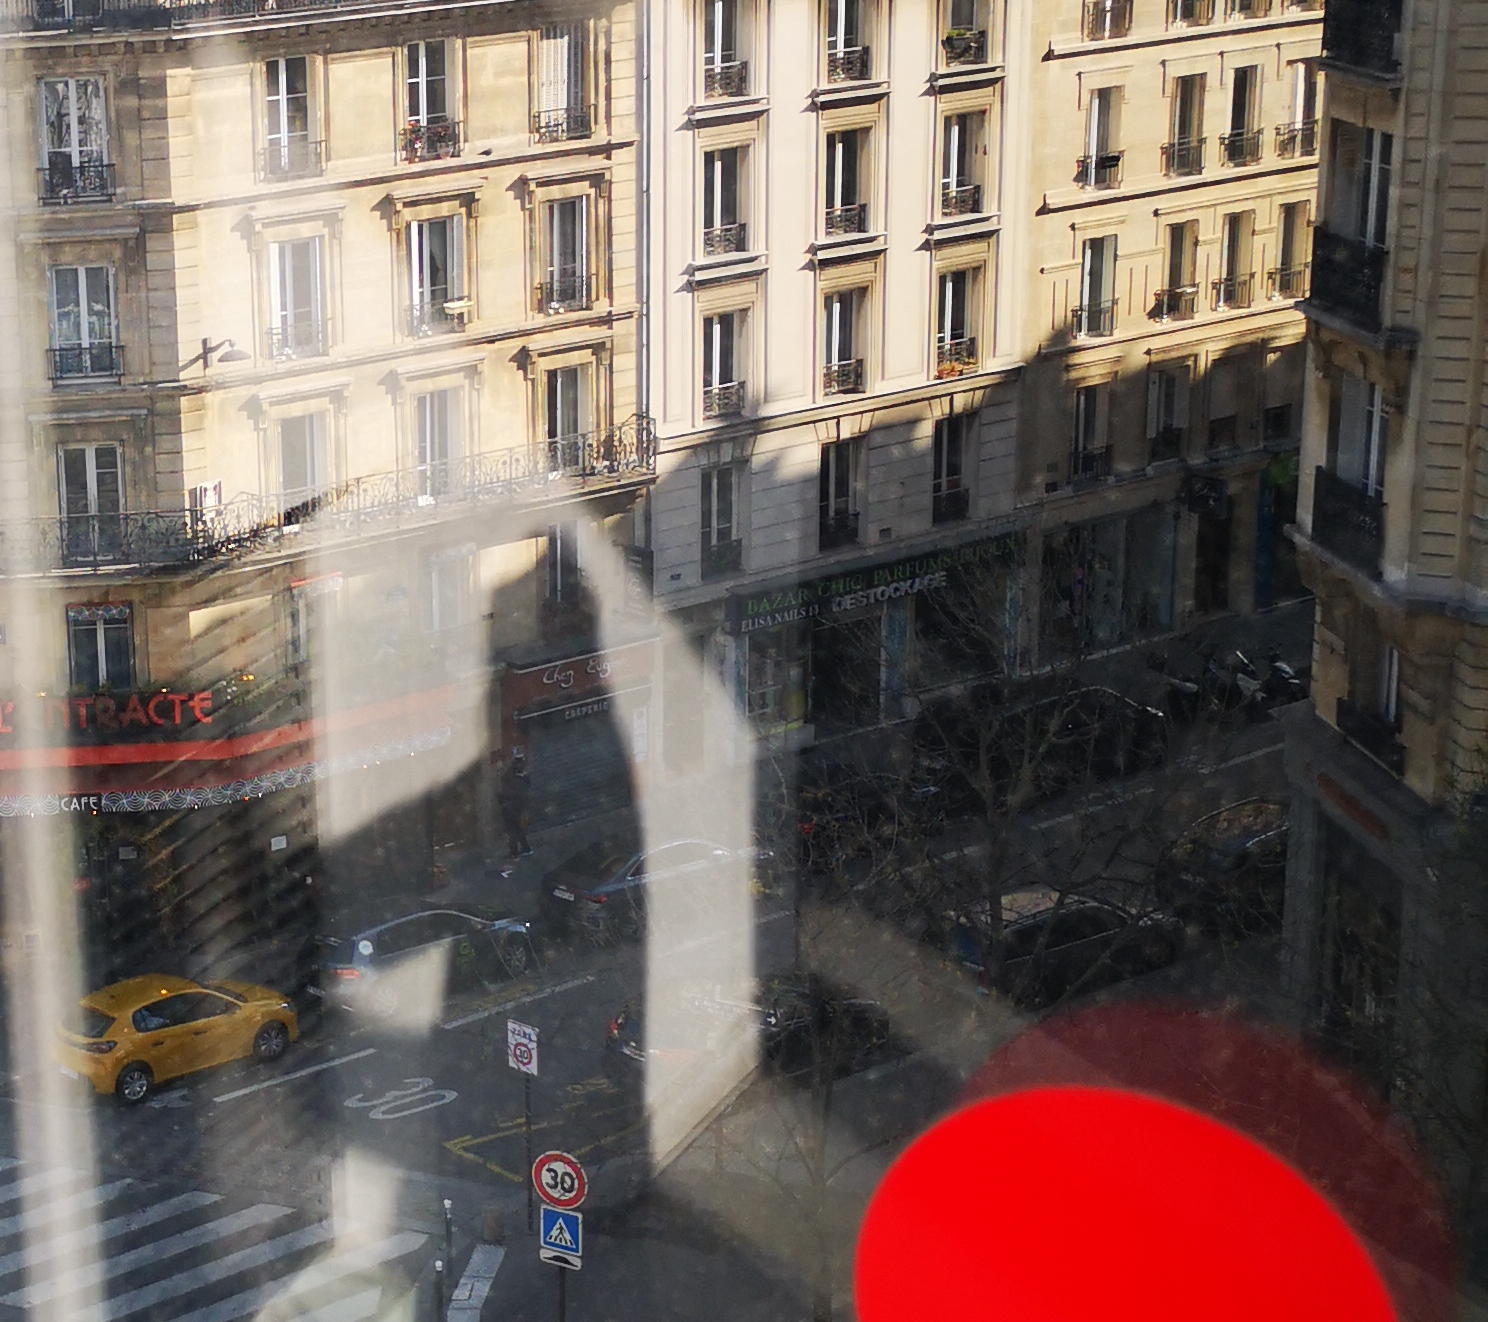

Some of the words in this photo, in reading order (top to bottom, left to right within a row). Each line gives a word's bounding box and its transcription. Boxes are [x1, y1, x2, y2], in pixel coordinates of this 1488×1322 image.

[747, 588, 809, 615] BAZAR
[817, 574, 863, 598] CHIC
[873, 552, 952, 585] PARFUMS
[542, 665, 574, 688] Chez
[343, 1076, 459, 1120] 30
[545, 1167, 576, 1194] 30
